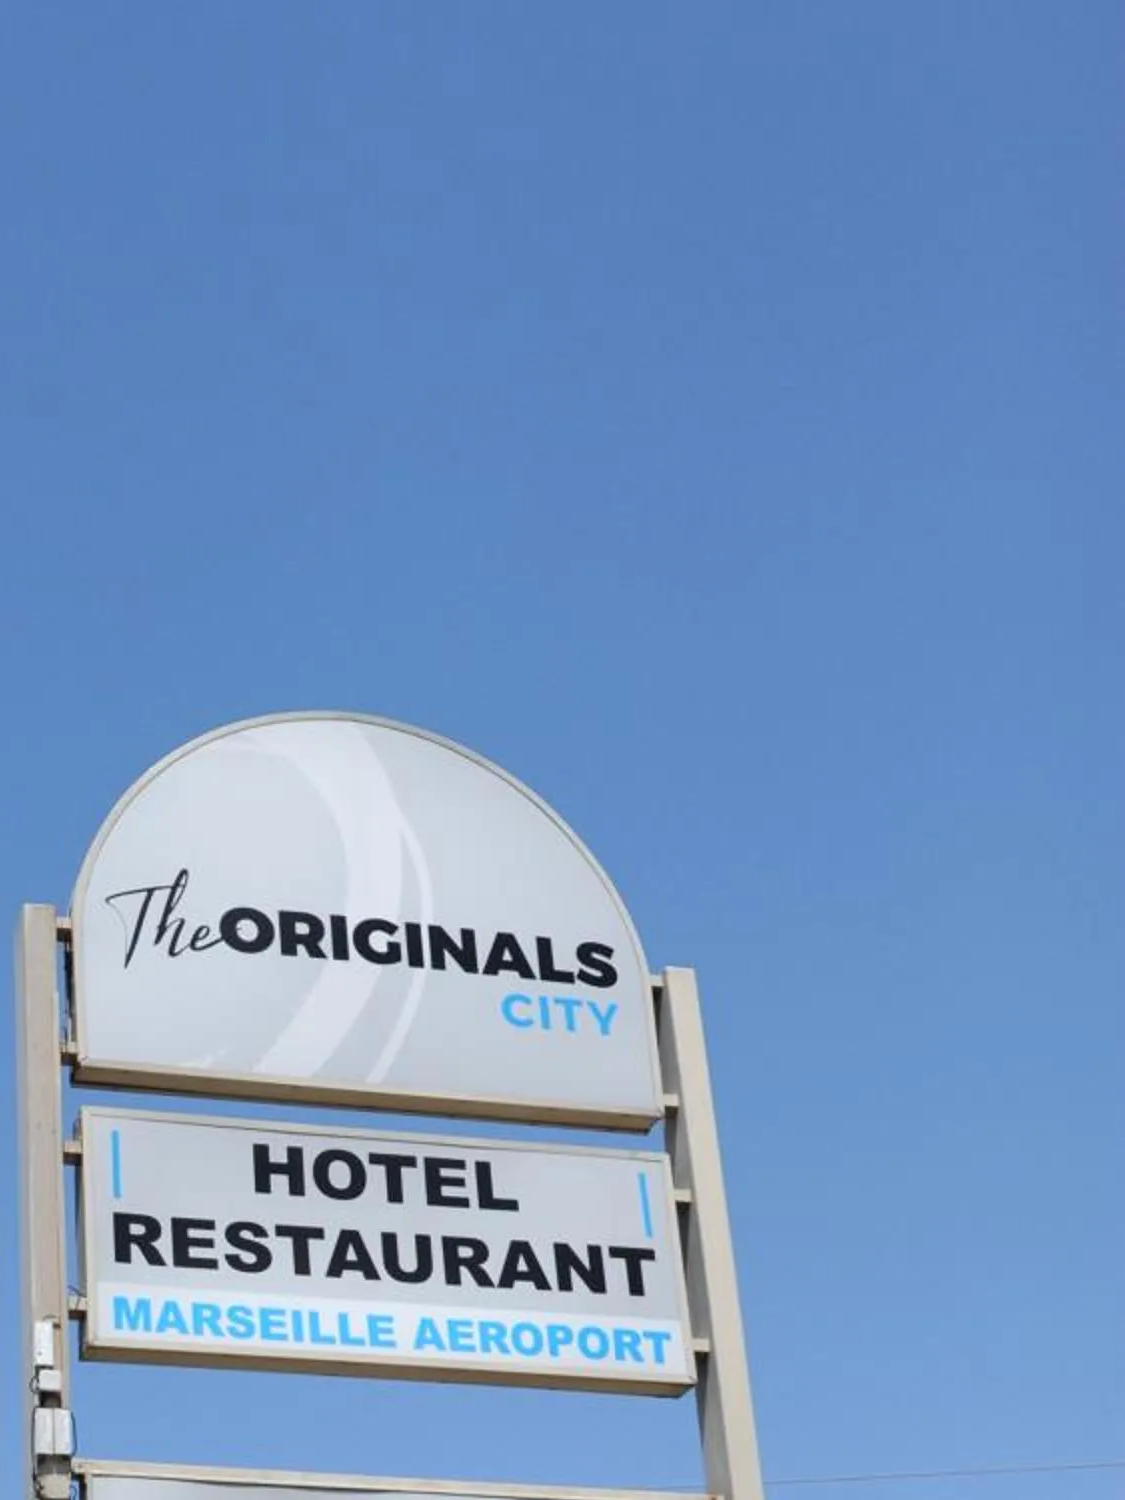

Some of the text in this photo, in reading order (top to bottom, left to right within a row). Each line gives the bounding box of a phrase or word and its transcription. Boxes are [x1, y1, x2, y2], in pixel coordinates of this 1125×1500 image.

[106, 869, 618, 989] The ORIGINALS
[500, 992, 618, 1036] CITY
[252, 1143, 520, 1212] HOTEL
[112, 1211, 656, 1297] RESTAURANT
[111, 1295, 672, 1366] MARSEILLE AEROPORT
